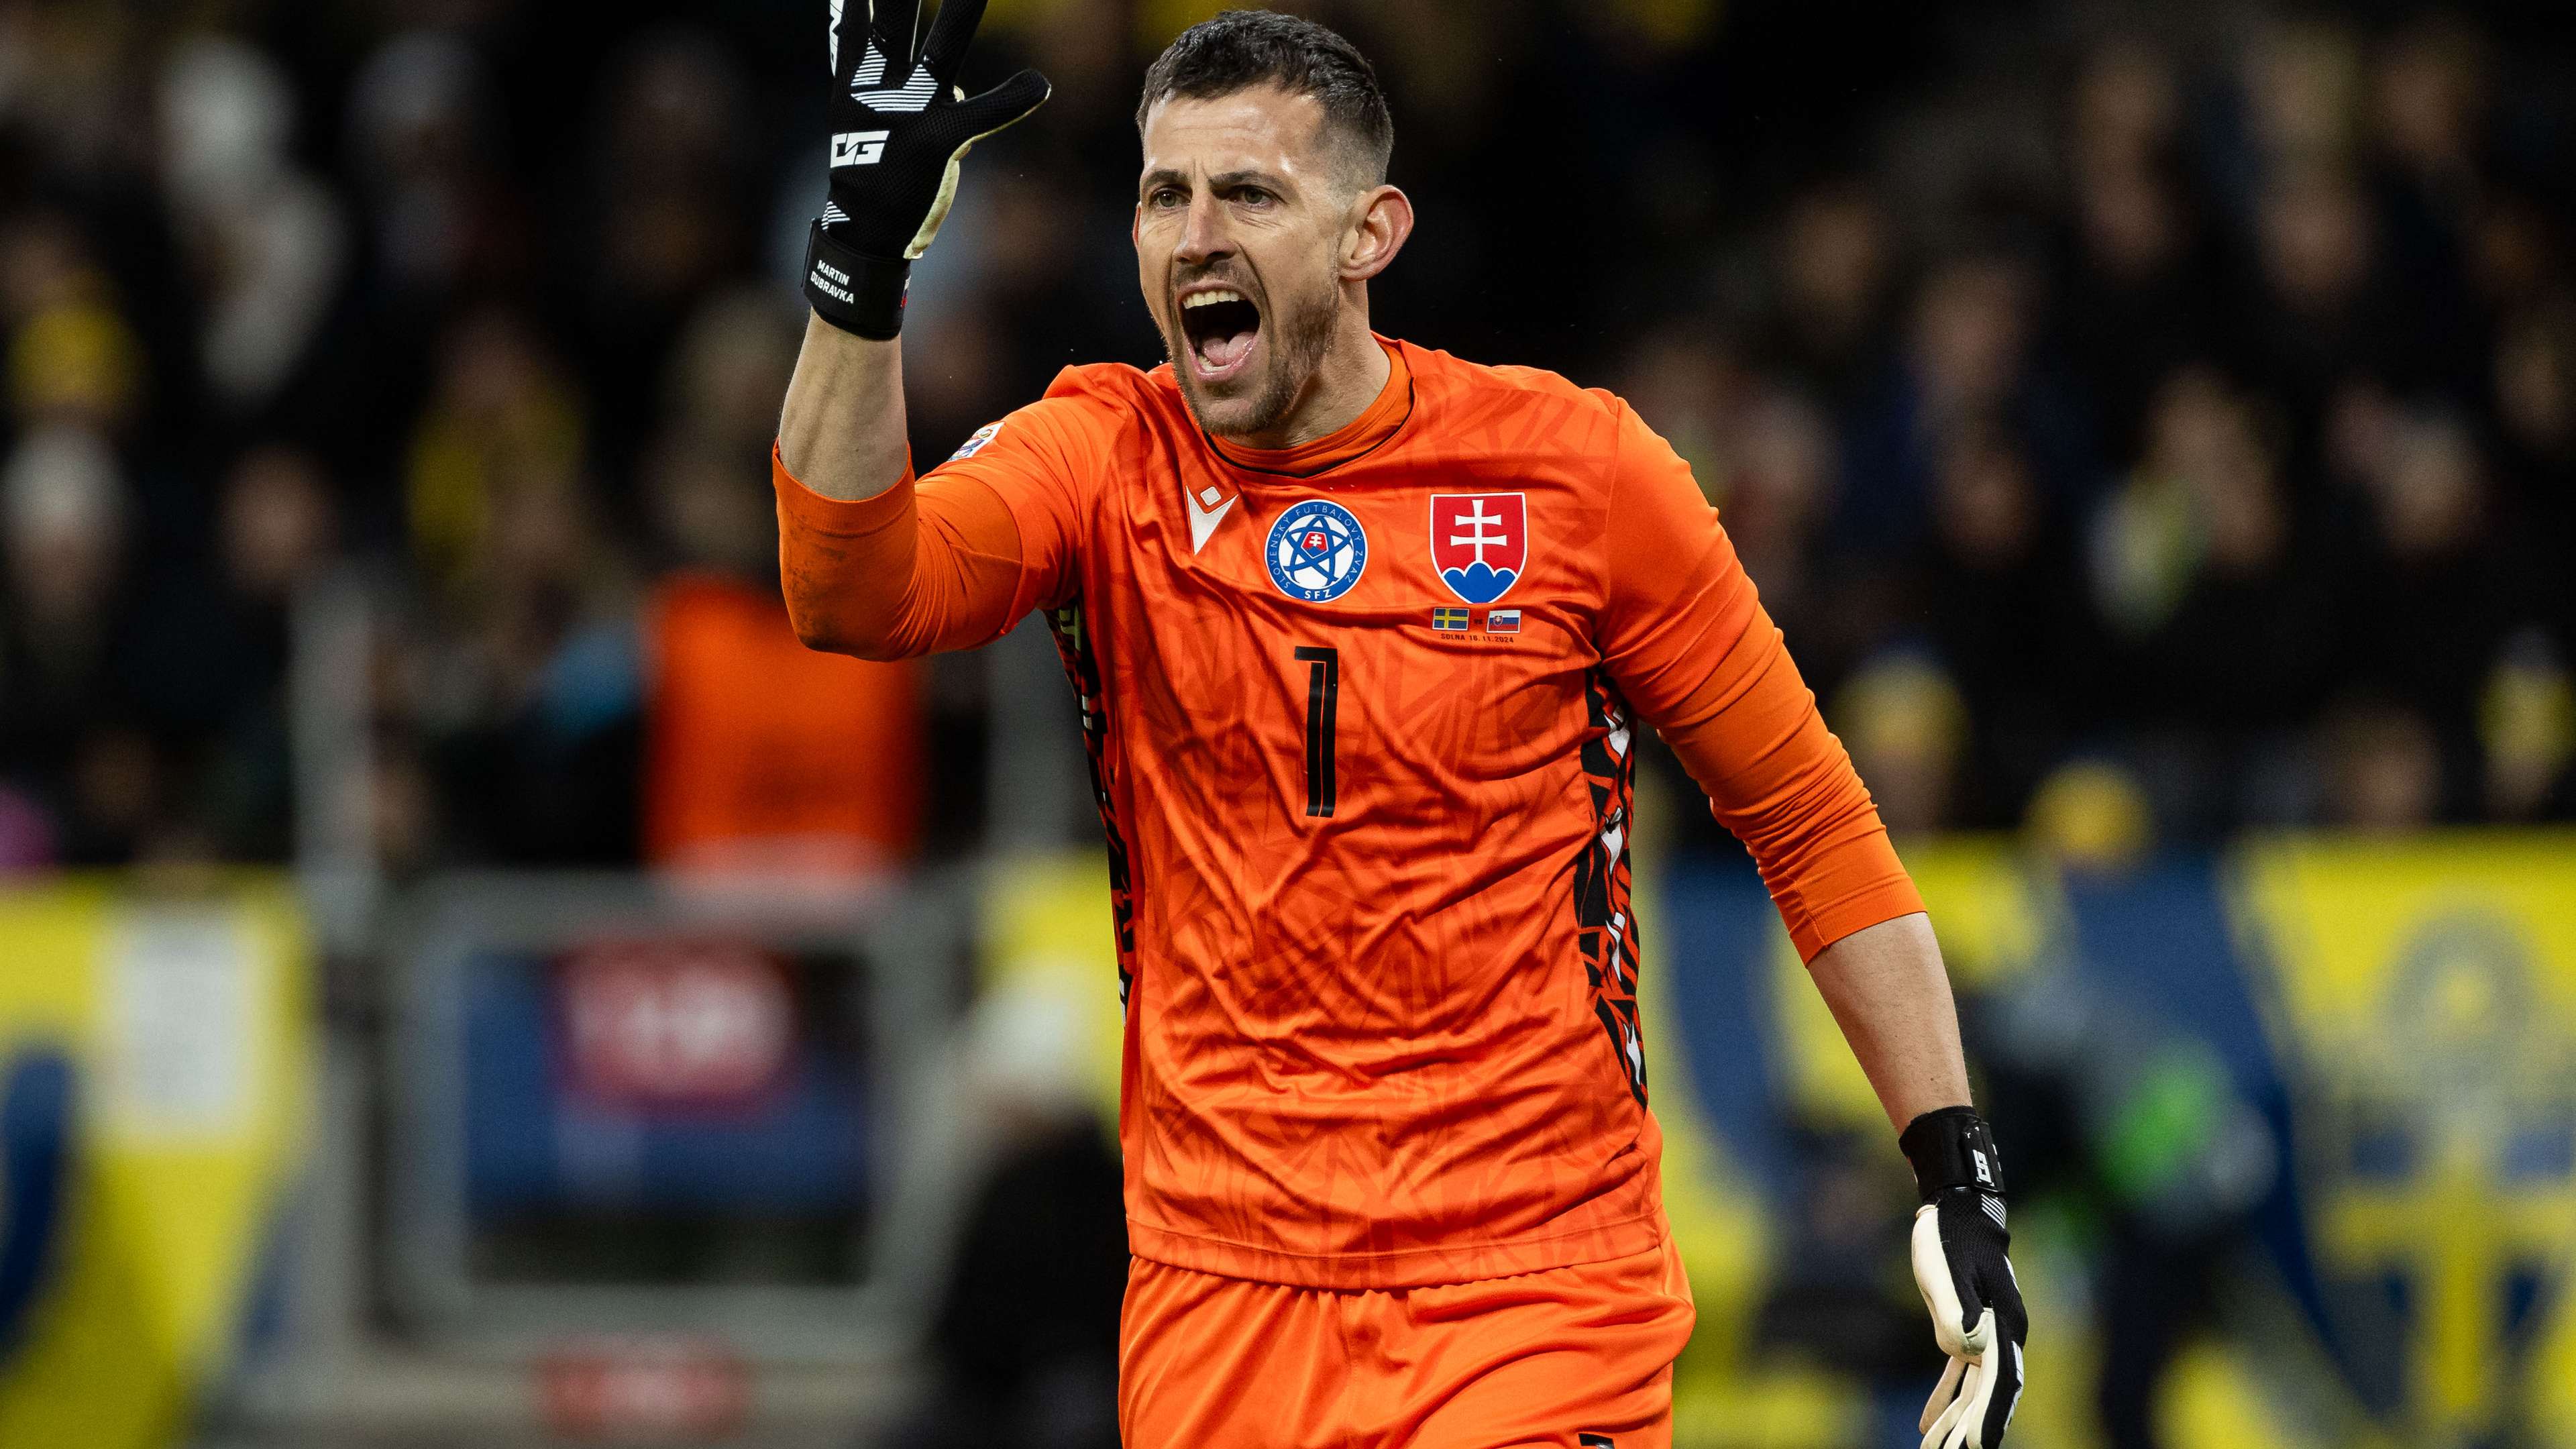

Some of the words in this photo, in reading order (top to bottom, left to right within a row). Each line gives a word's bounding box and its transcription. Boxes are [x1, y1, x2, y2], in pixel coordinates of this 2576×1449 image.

[810, 271, 854, 304] DUBRAVKA
[817, 260, 849, 286] MARTIN
[1270, 516, 1291, 589] SLOVENSKÝ
[1295, 504, 1363, 541] FUTBALOVÝ
[1304, 590, 1332, 599] SFZ
[1294, 646, 1338, 818] 1
